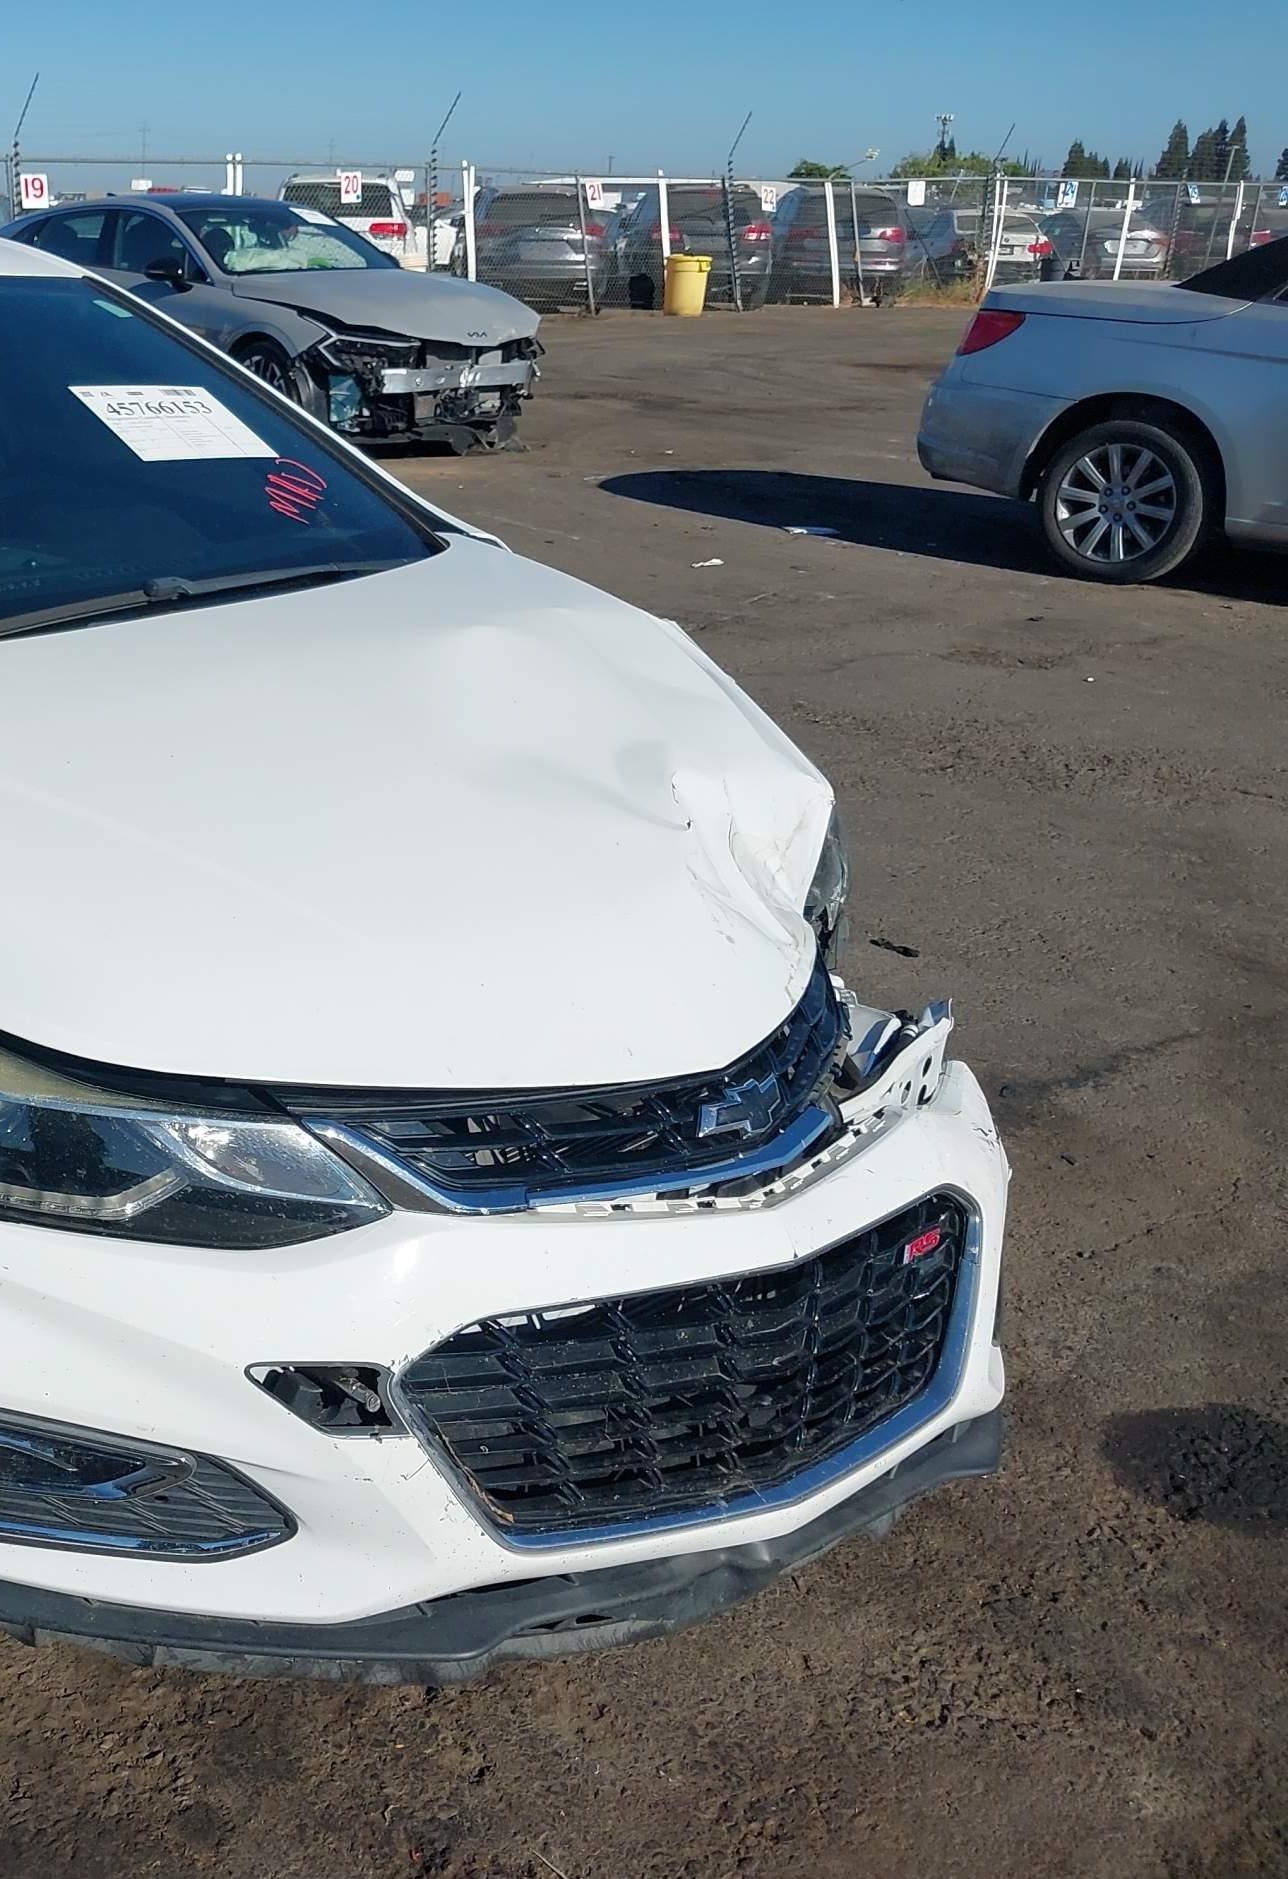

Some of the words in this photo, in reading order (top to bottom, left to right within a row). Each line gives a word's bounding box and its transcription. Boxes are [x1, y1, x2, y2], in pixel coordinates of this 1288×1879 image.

[24, 177, 44, 199] 19
[344, 175, 359, 194] 20
[588, 183, 602, 201] 21
[763, 188, 775, 205] 22
[106, 401, 214, 416] 45766153
[908, 1228, 941, 1264] RS
